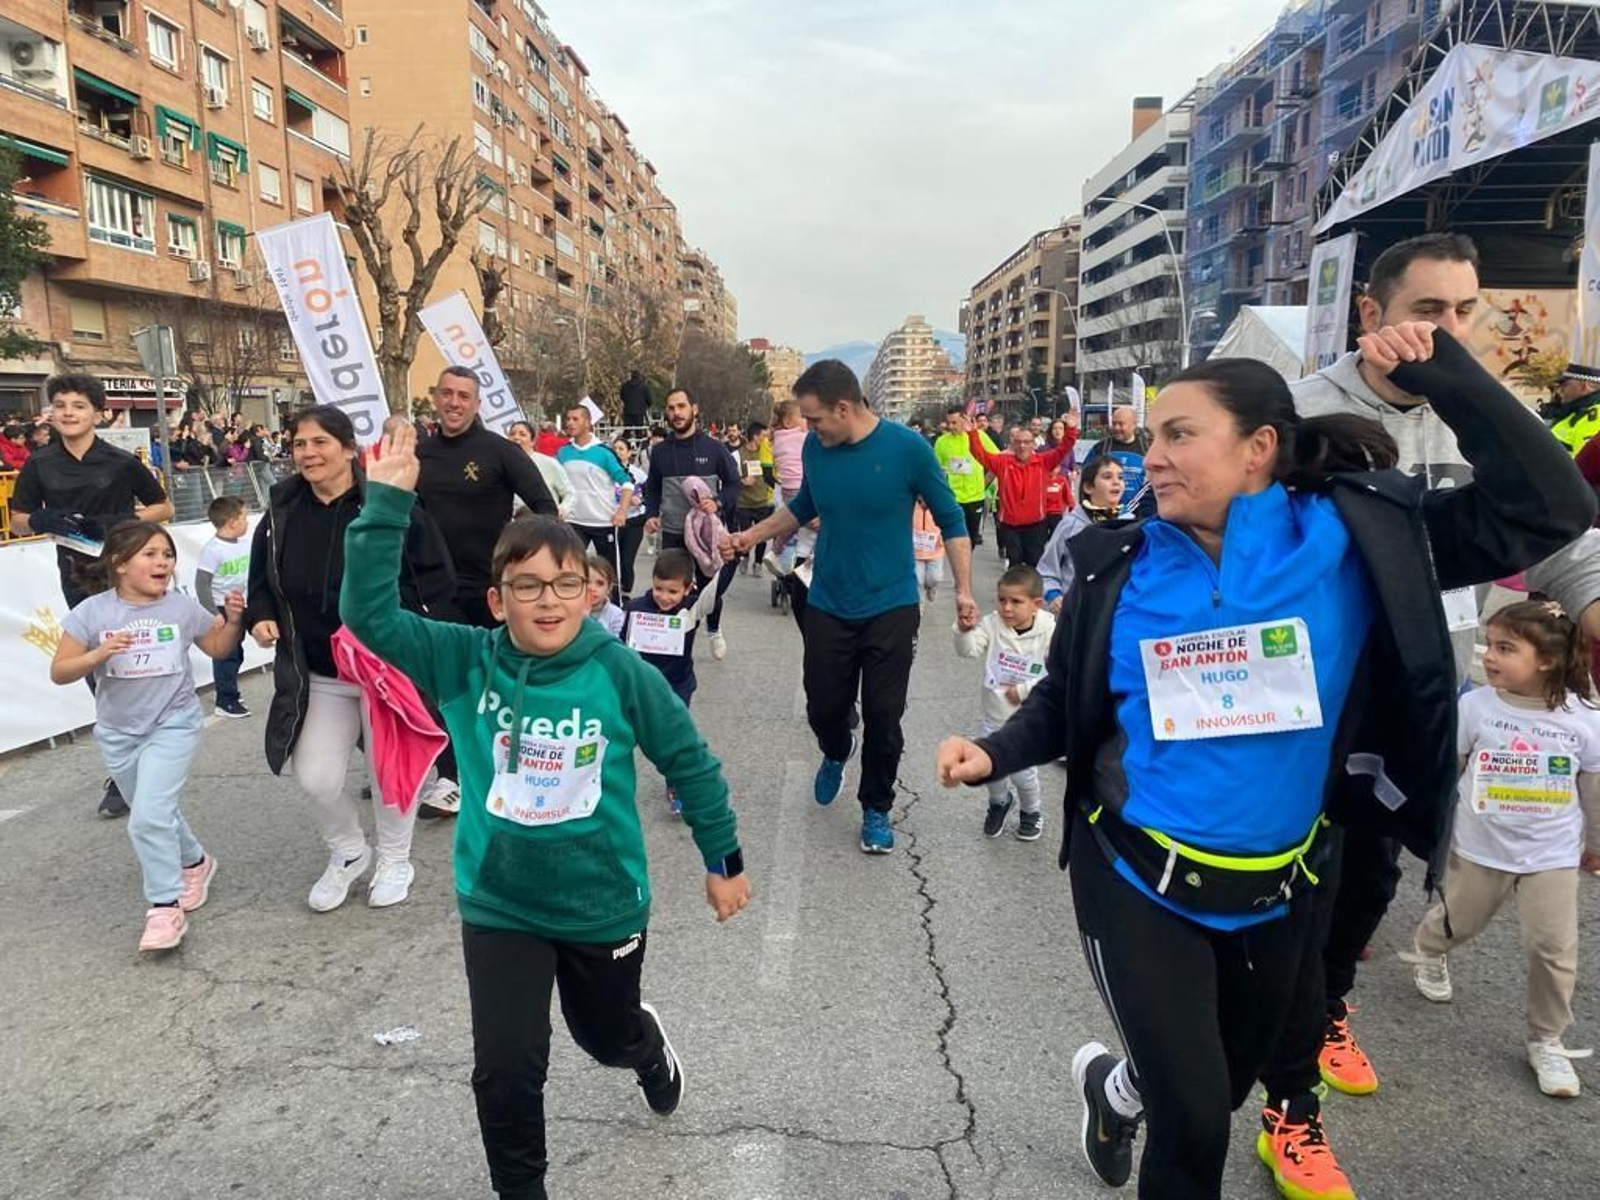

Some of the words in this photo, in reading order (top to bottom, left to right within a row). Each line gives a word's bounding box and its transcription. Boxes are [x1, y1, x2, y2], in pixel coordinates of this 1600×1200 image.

[1429, 87, 1456, 124] SAN
[1177, 639, 1225, 655] NOCHE
[1228, 636, 1247, 649] DE
[134, 653, 151, 666] 77
[1160, 656, 1192, 671] SAN
[1195, 648, 1248, 666] ANTÓN
[1200, 668, 1249, 685] HUGO
[1221, 693, 1234, 709] 8
[1196, 711, 1276, 730] INNOVASUR
[519, 746, 546, 758] OCHE
[549, 750, 565, 760] DE
[1491, 756, 1523, 765] NOCHE
[1525, 758, 1538, 766] DE
[1480, 763, 1500, 772] SAN
[524, 774, 561, 788] HUGO
[612, 938, 640, 961] PUMA
